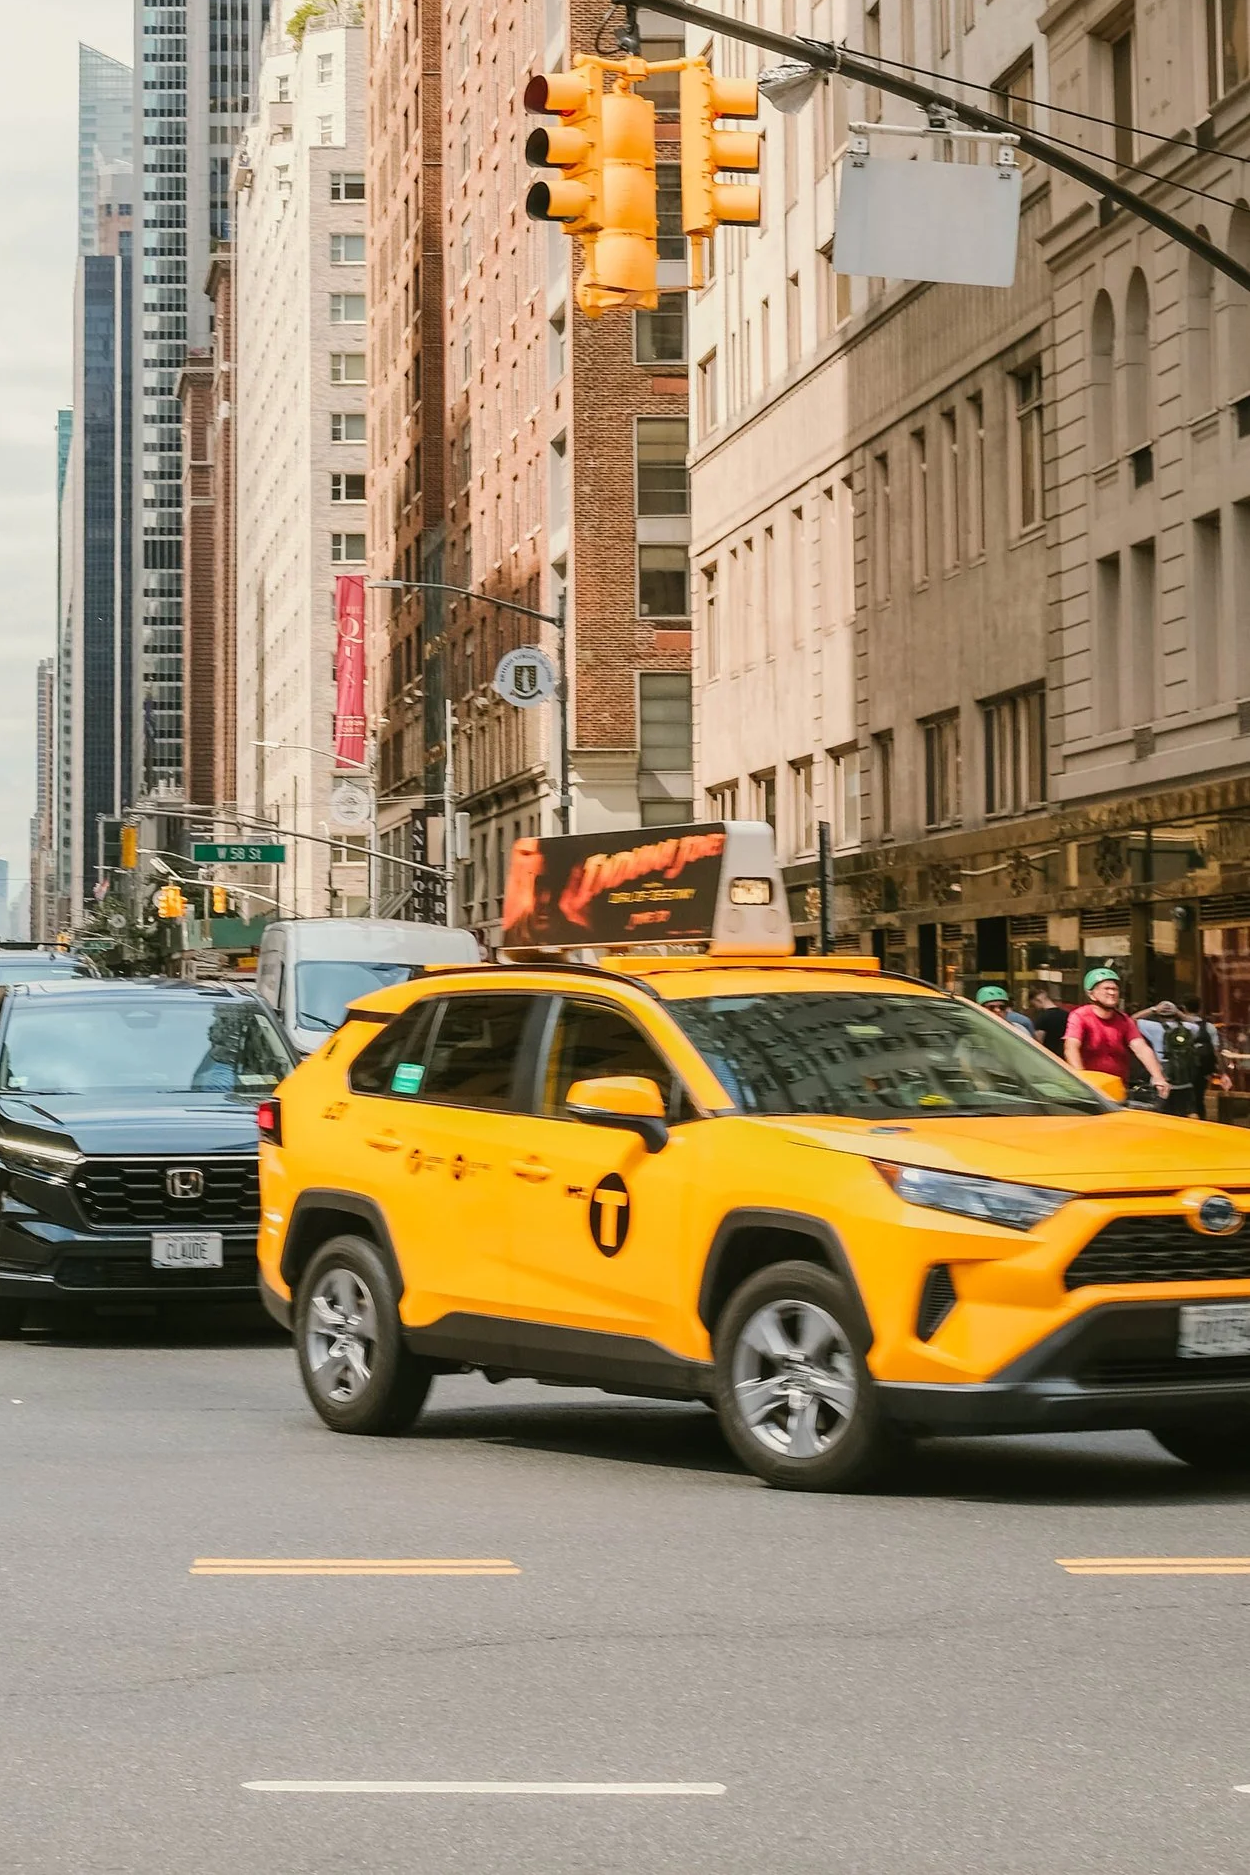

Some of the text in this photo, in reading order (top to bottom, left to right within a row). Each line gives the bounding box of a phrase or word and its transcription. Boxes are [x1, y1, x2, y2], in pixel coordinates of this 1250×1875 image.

[216, 847, 261, 860] W 58 St
[594, 1188, 627, 1247] T
